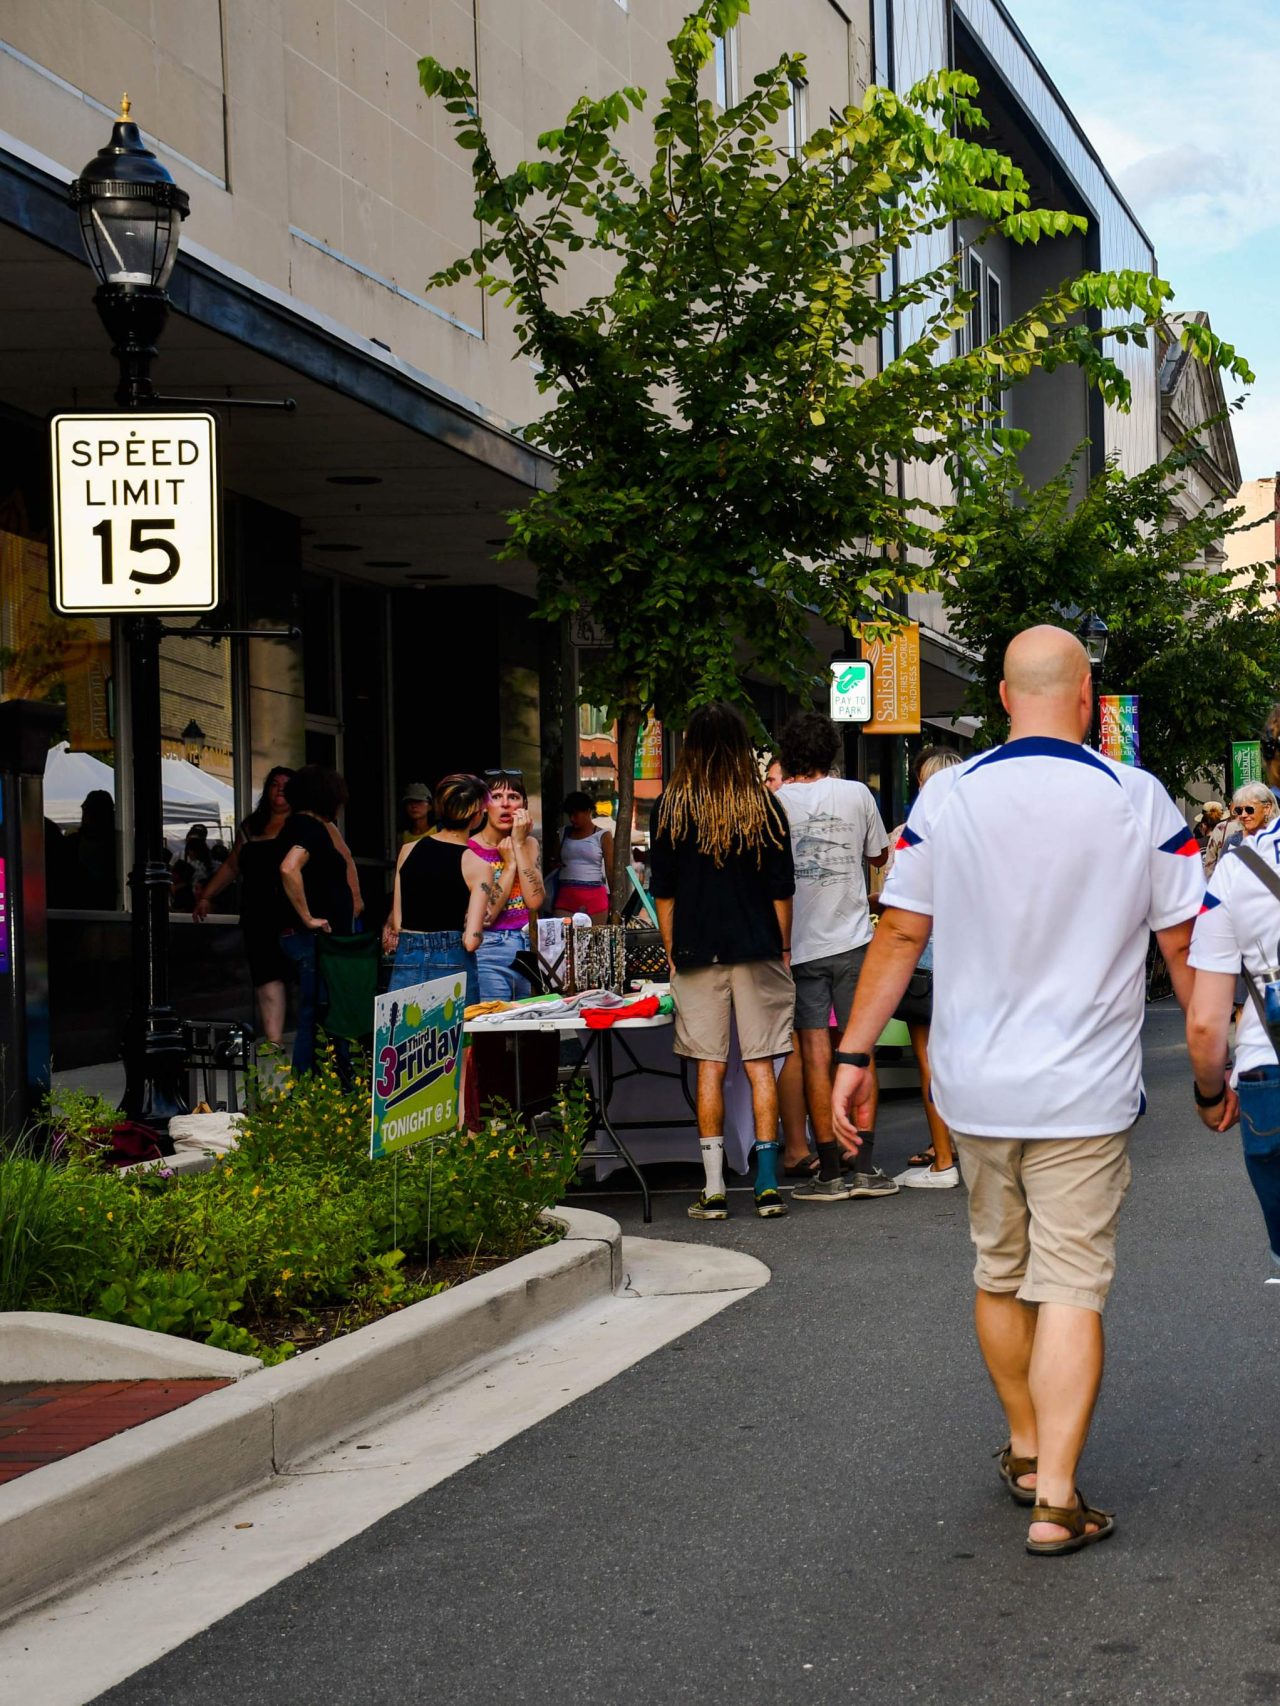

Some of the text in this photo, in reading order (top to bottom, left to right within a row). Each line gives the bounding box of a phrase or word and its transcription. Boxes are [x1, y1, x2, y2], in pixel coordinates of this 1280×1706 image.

[72, 440, 199, 466] SPEED
[86, 479, 185, 506] LIMIT
[92, 518, 181, 585] 15
[908, 643, 918, 712] KINDNESS CITY
[835, 696, 866, 705] PAY TO
[839, 706, 862, 715] PARK
[1119, 705, 1138, 714] ARE
[1101, 724, 1138, 736] EQUAL
[1102, 735, 1132, 745] HERE
[1240, 746, 1251, 785] alisbury
[407, 1027, 430, 1051] Third
[377, 1020, 464, 1098] 3 Friday
[381, 1099, 452, 1144] TONIGHT @ 5
